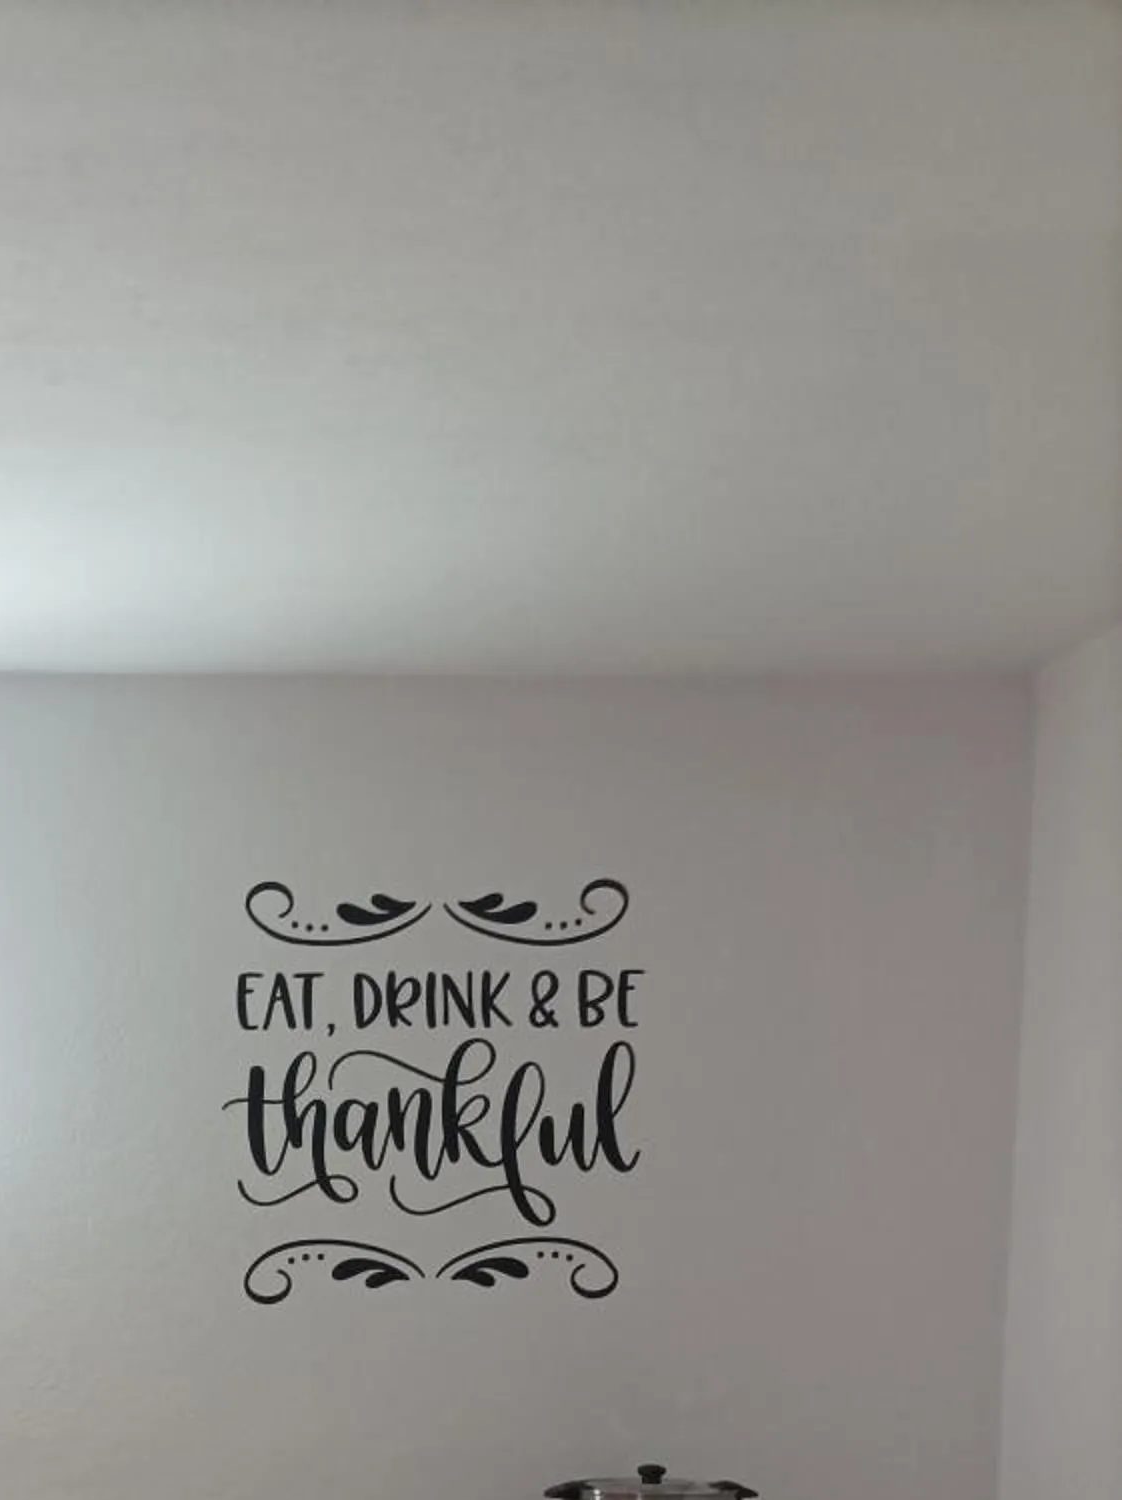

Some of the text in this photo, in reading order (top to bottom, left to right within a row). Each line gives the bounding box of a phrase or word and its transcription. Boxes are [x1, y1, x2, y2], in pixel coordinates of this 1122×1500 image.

[236, 969, 647, 1037] EAT, DRINK & BE
[221, 1037, 641, 1227] thankful
